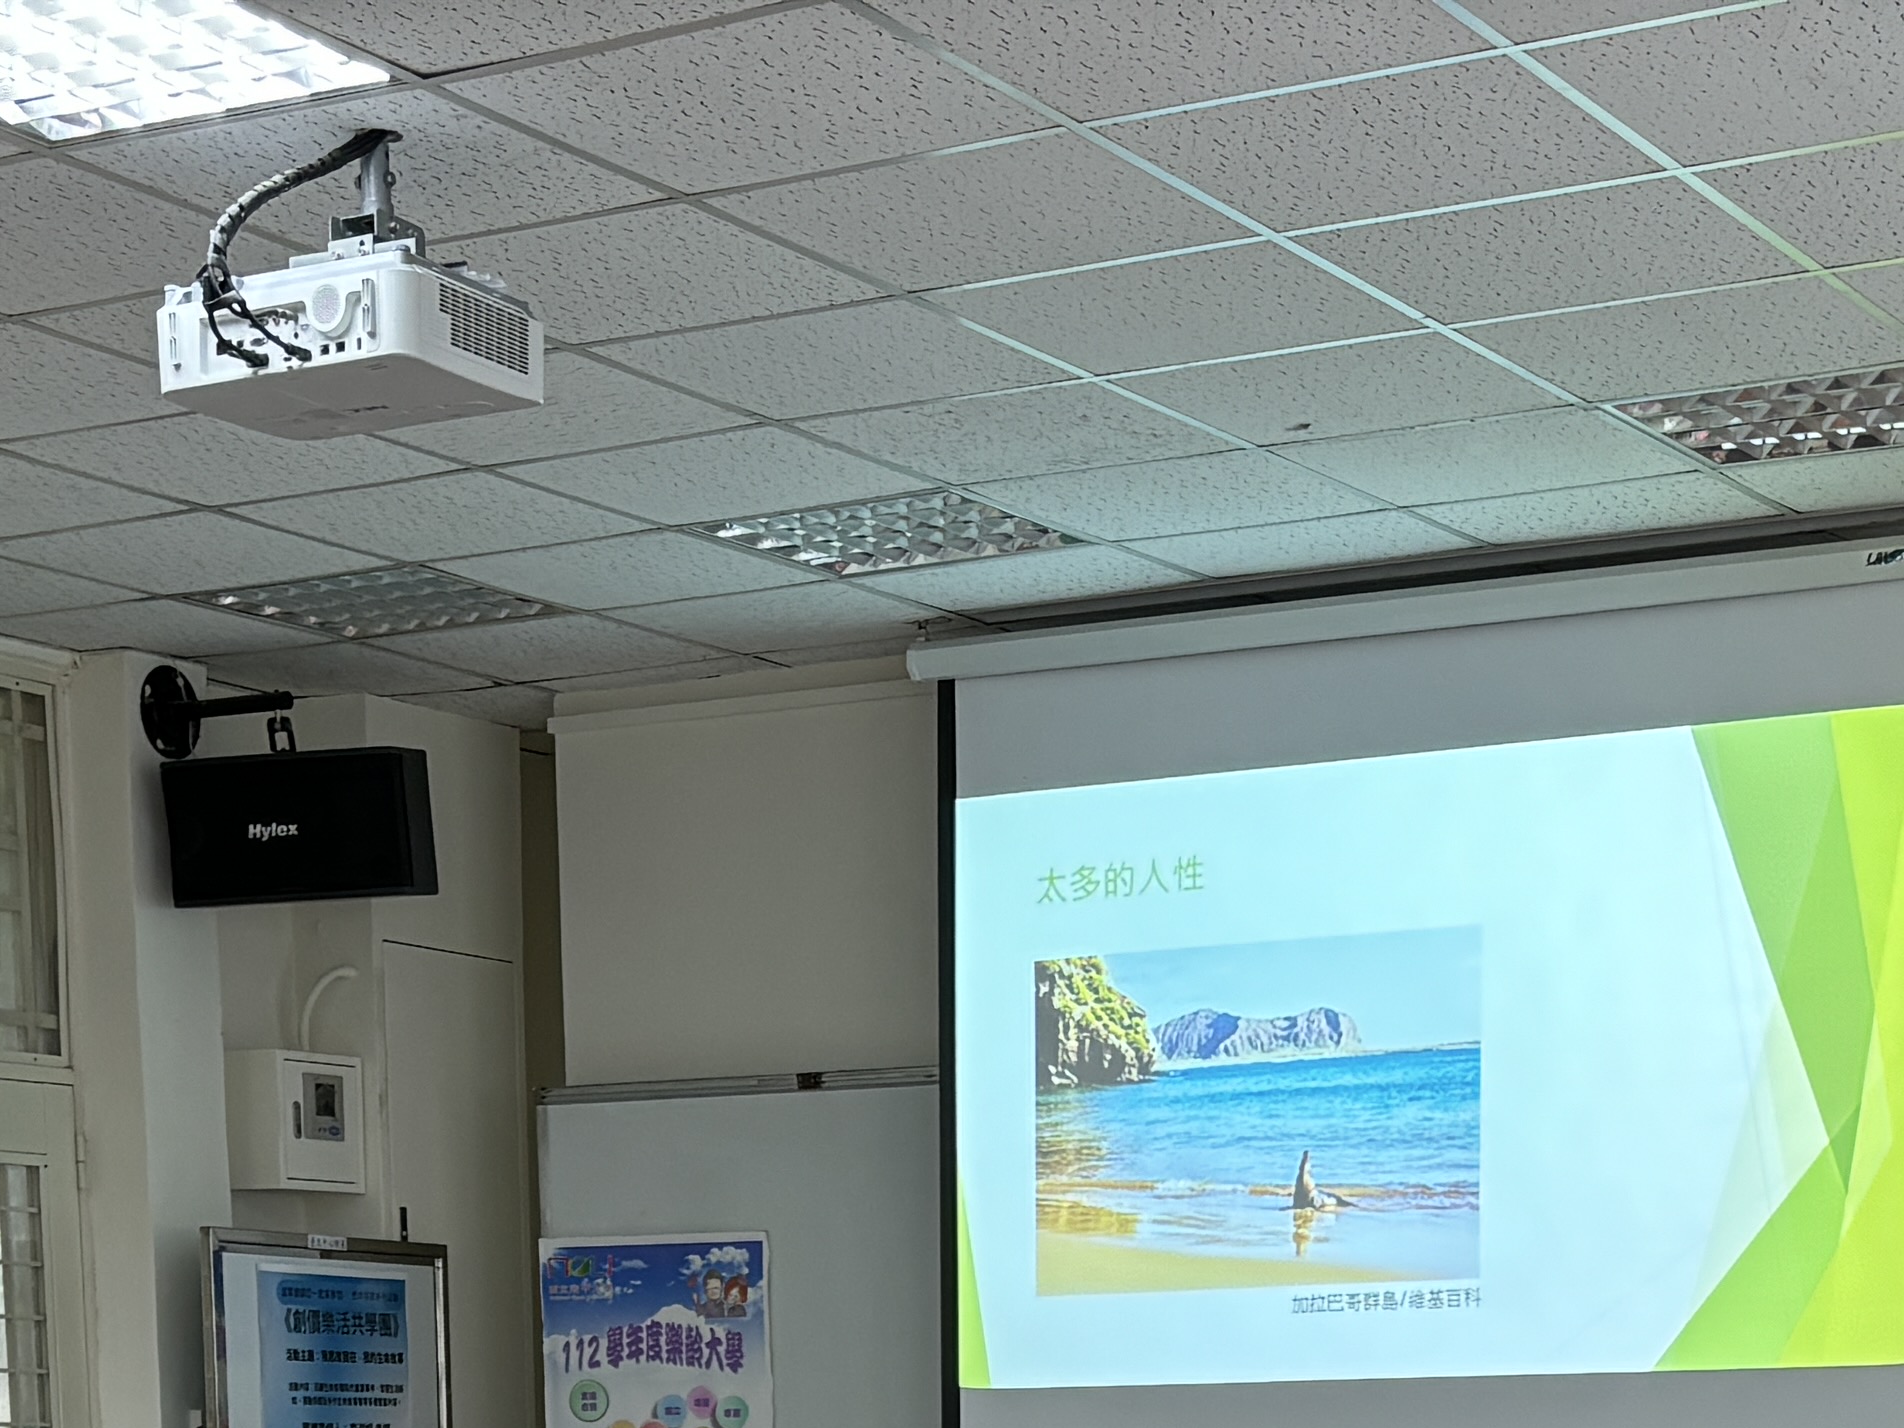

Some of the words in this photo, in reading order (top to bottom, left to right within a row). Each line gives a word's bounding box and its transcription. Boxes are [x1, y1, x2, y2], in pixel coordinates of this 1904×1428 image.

[248, 822, 298, 841] Hylex
[1037, 855, 1204, 904] 太多的人性
